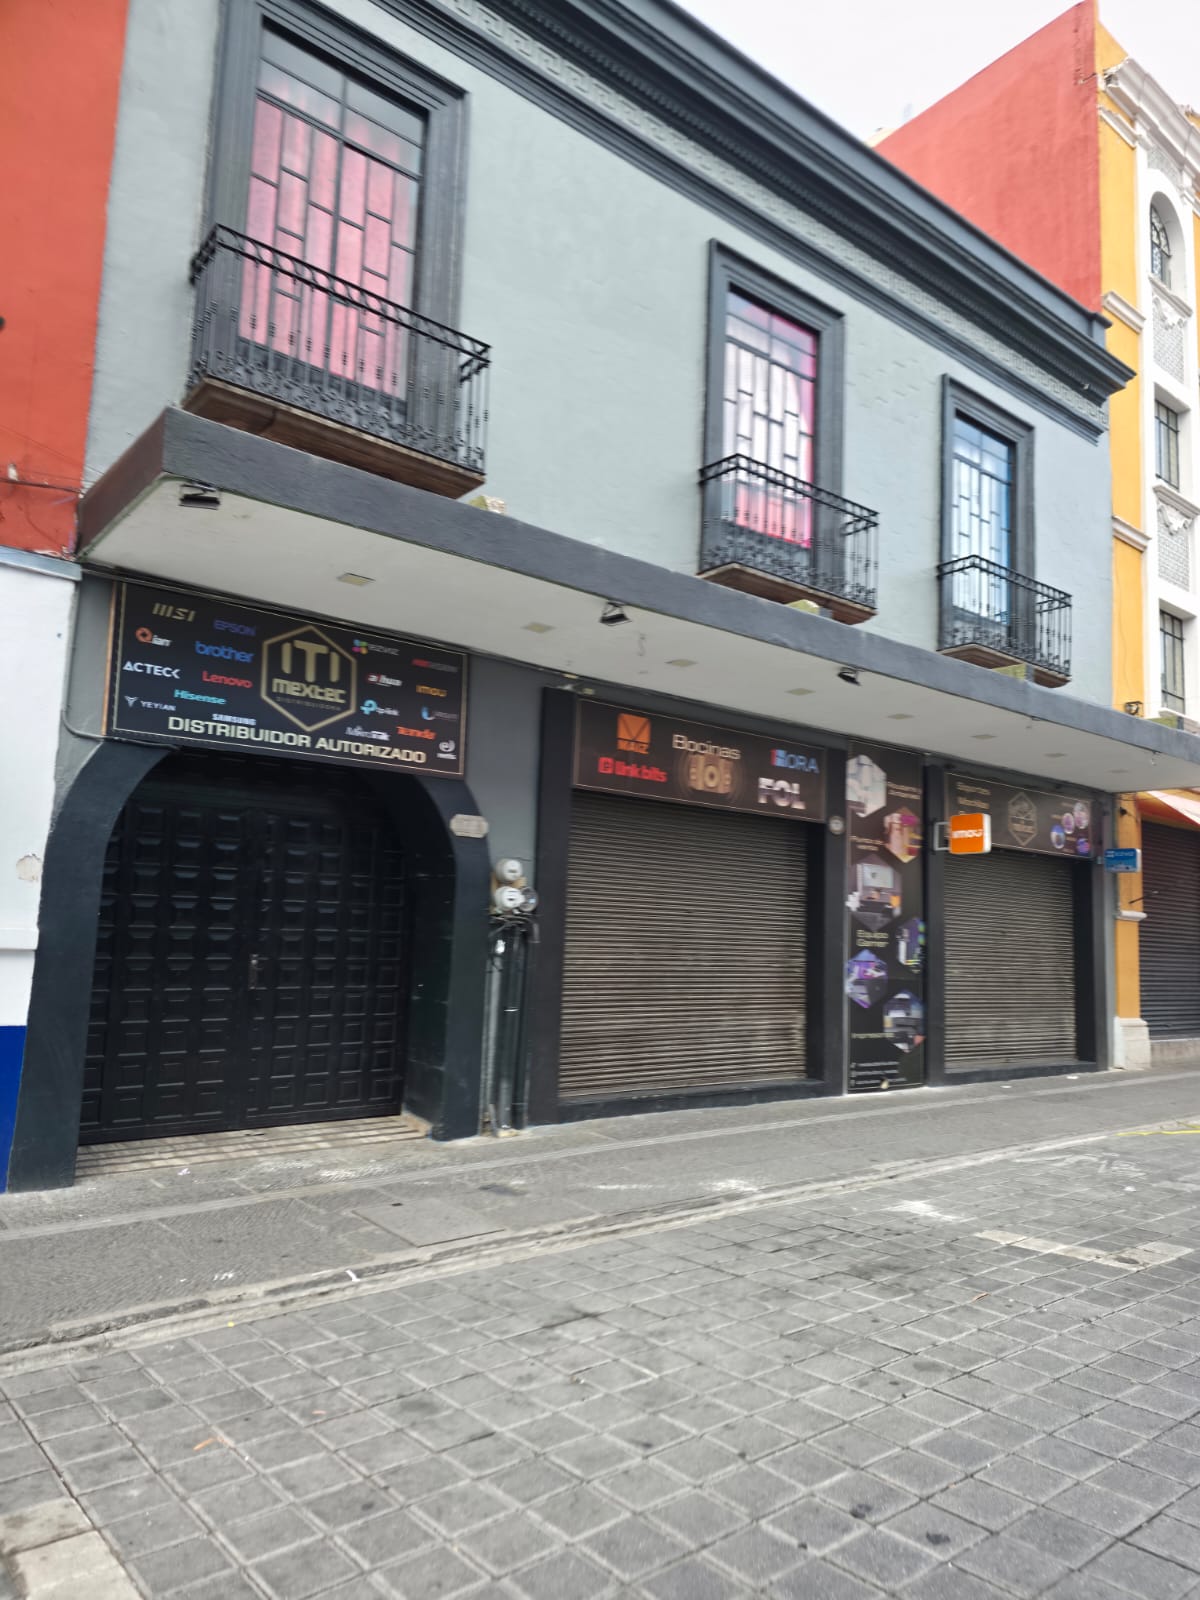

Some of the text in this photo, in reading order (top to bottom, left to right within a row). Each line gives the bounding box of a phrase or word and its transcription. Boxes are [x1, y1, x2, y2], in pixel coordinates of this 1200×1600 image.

[213, 620, 256, 636] EPSON
[195, 641, 254, 663] brother
[123, 661, 181, 679] ACTECK
[202, 671, 253, 688] Lenovo
[174, 689, 226, 705] Hisense
[212, 713, 257, 726] SAMSUNG
[168, 717, 311, 748] DISTRIBUIDOR
[315, 737, 427, 763] AUTORIZADO
[672, 733, 741, 760] Bocinas
